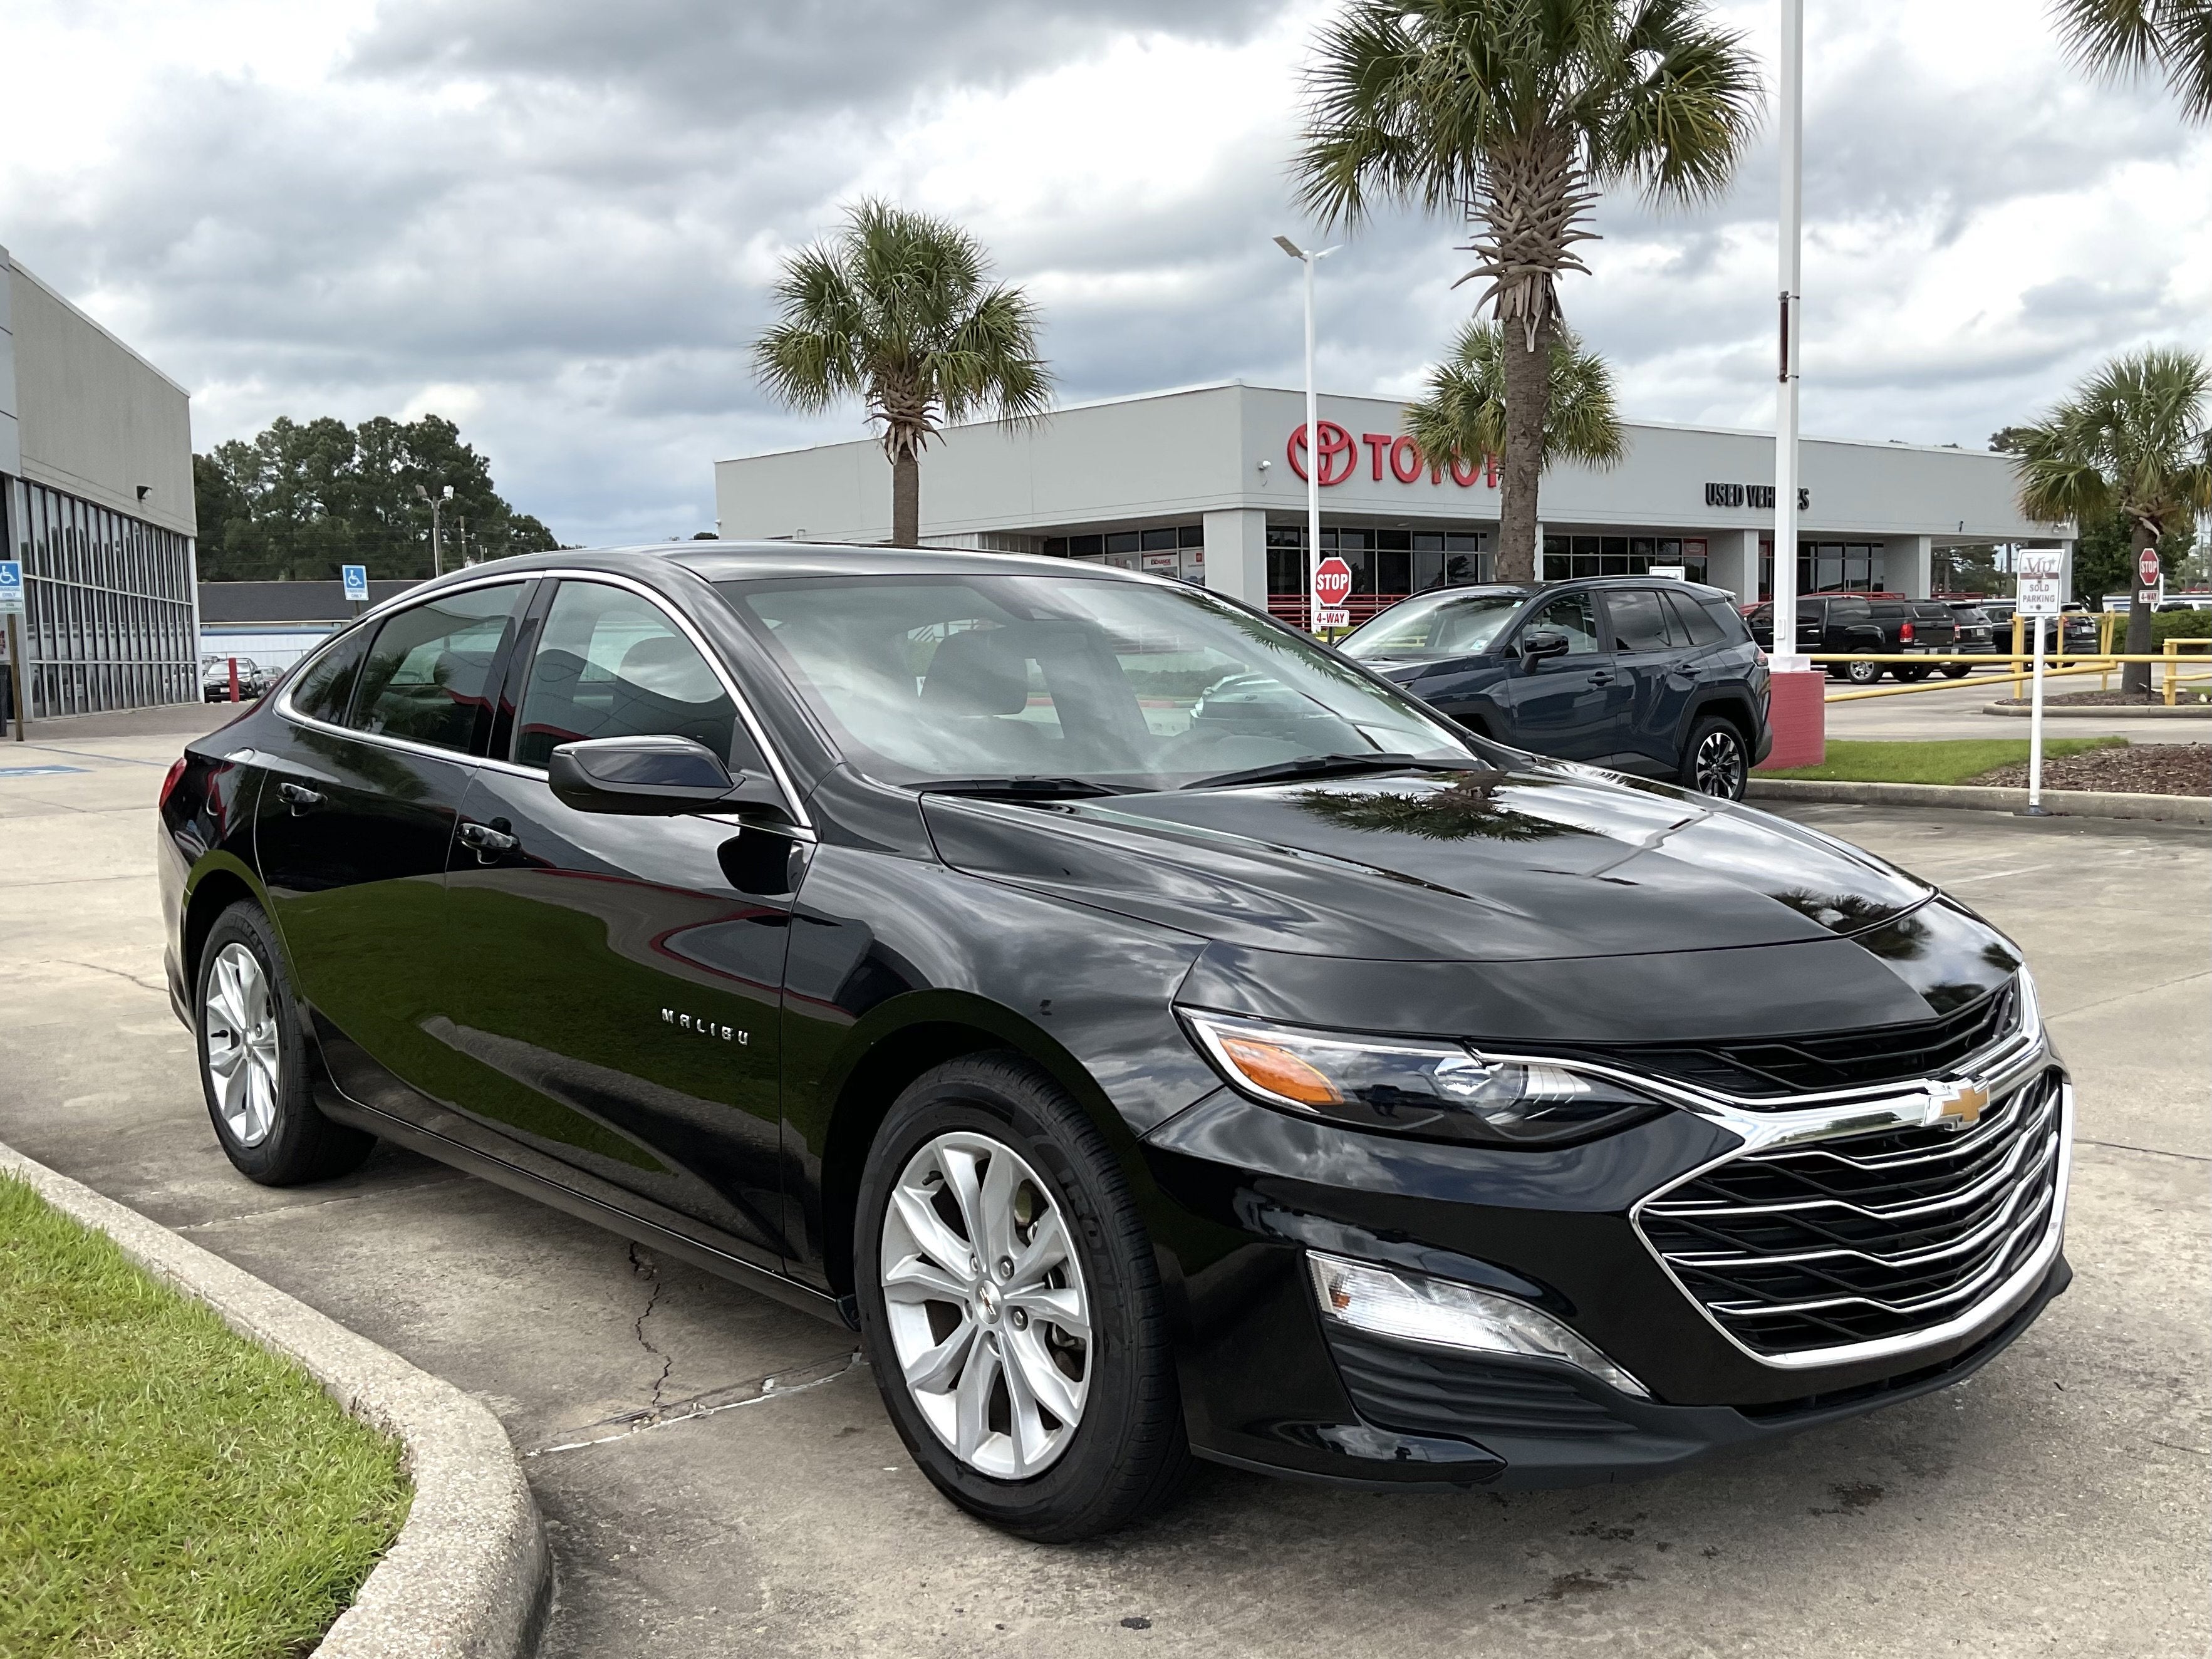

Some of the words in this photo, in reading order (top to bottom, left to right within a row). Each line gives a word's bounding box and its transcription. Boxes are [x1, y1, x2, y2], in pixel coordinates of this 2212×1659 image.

[1705, 483, 1744, 507] USED
[1746, 485, 1810, 510] VEHS
[2141, 561, 2157, 573] STOP
[1317, 573, 1348, 590] STOP
[2030, 584, 2049, 592] SOLD
[2023, 595, 2055, 603] PARKING
[1317, 613, 1344, 623] 4-WAY
[662, 1008, 749, 1046] MALIBU
